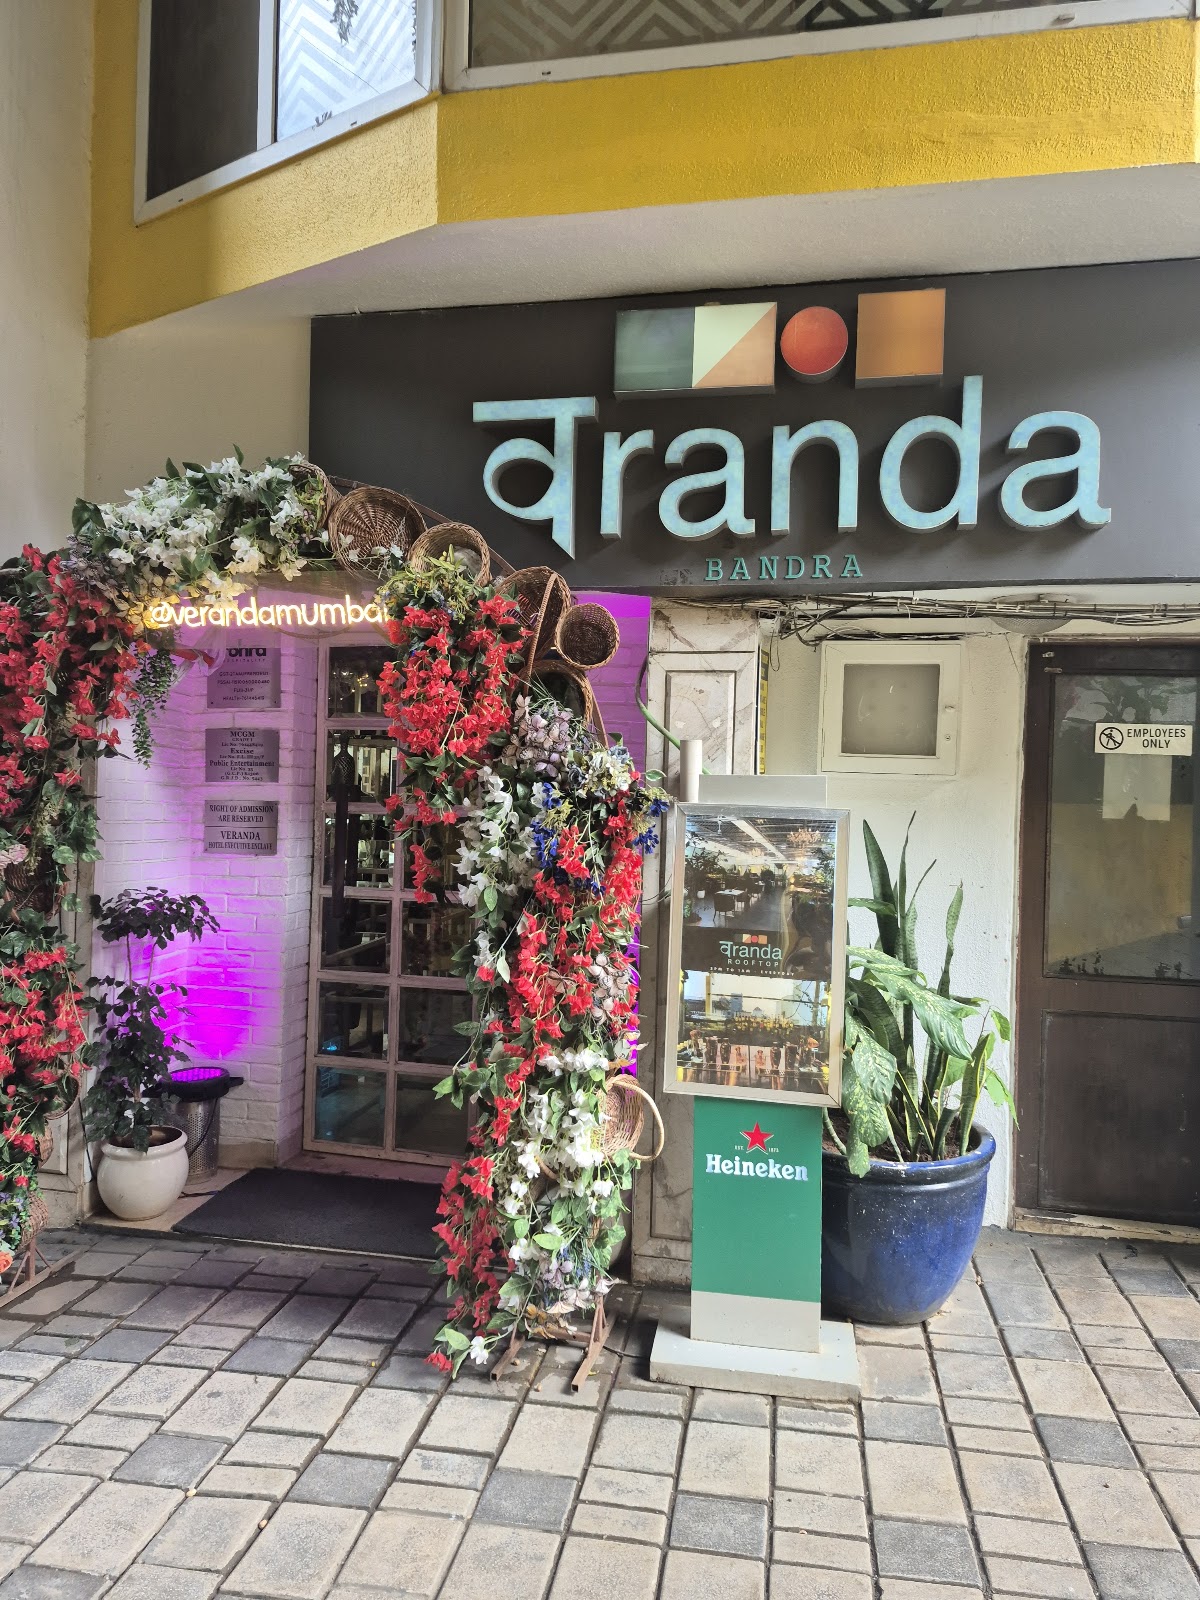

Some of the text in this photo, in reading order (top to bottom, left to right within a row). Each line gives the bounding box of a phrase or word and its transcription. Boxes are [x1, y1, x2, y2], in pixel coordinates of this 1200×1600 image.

[704, 554, 864, 581] BANDRA
[1127, 728, 1186, 738] EMPLOYEES
[1142, 739, 1171, 748] ONLY
[220, 831, 261, 840] VERANDA
[728, 959, 779, 967] ROOFTOP
[706, 1154, 808, 1181] Heineken
